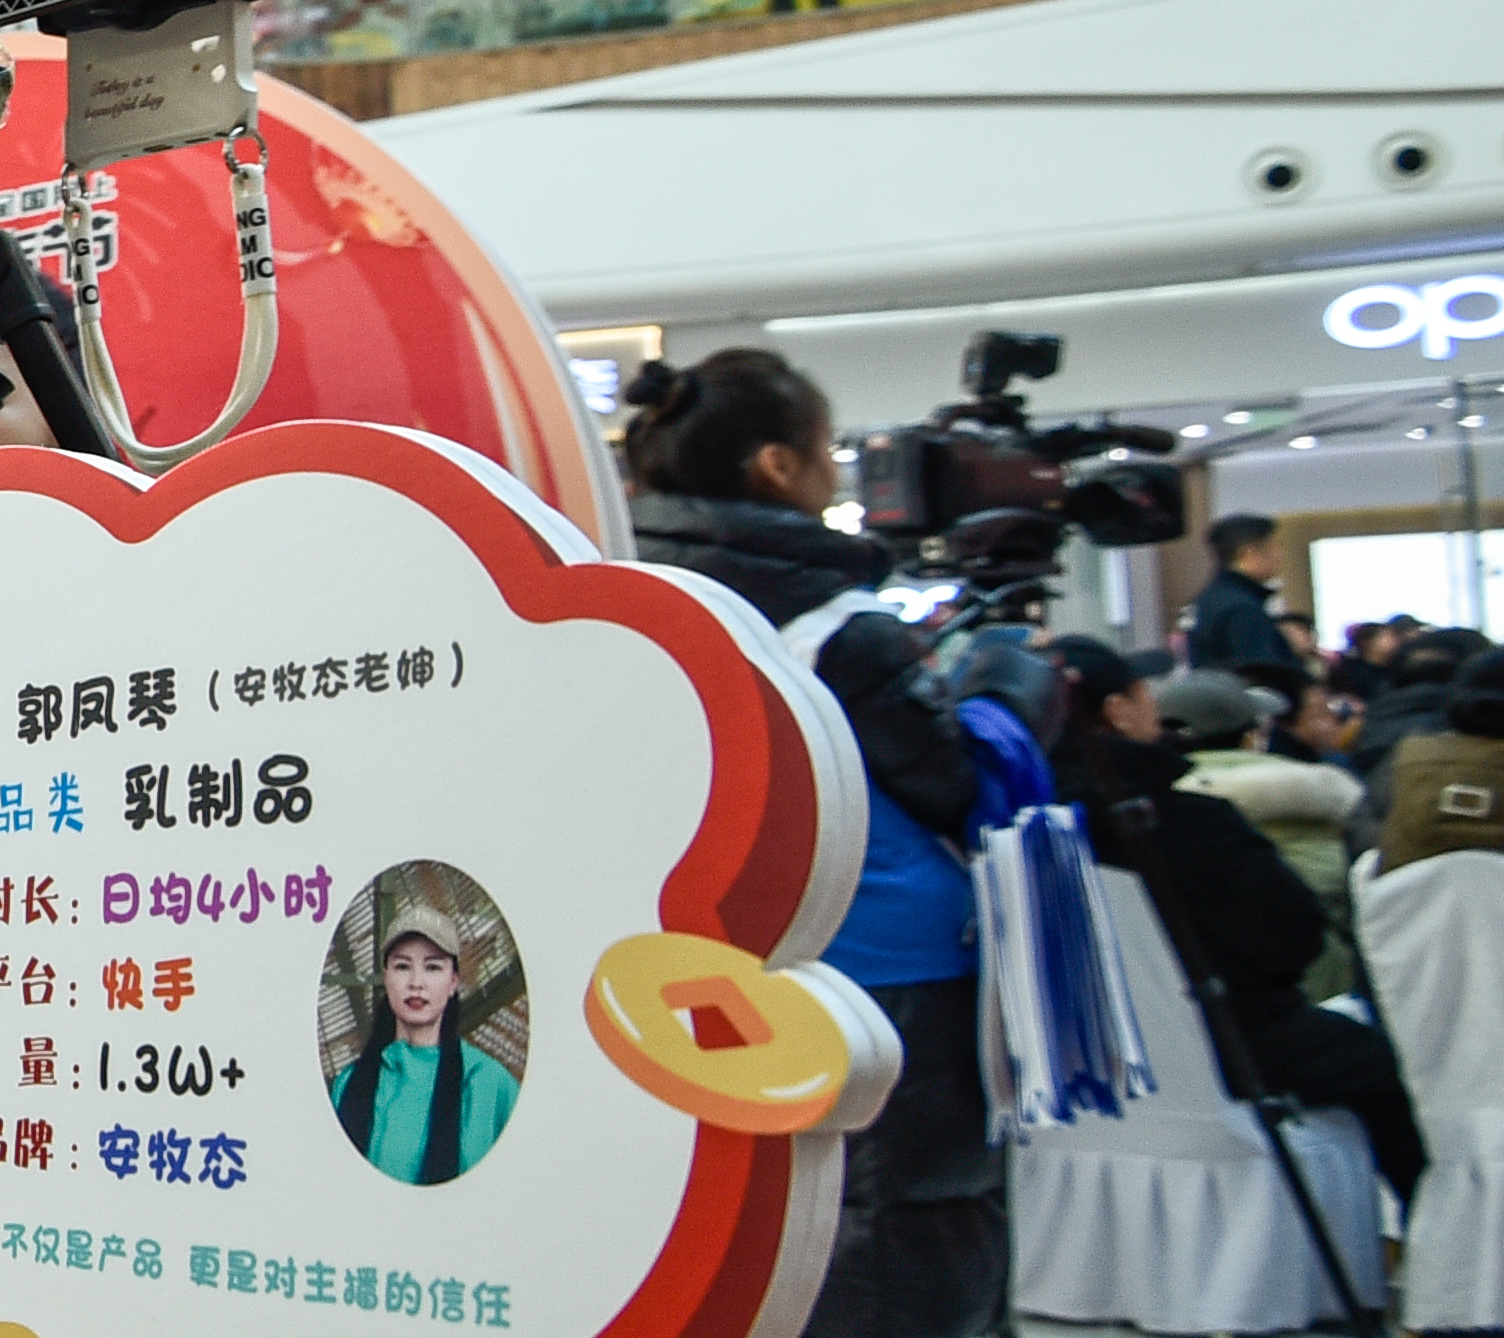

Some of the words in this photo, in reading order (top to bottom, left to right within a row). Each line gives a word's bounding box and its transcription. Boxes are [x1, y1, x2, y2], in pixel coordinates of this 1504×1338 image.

[17, 667, 177, 745] 郭凤琴
[123, 753, 313, 831] 乳制品
[102, 863, 333, 925] 日均4小时
[102, 956, 197, 1012] 快手
[97, 1123, 248, 1190] 安牧态
[188, 1244, 512, 1329] 更是对主播的信任
